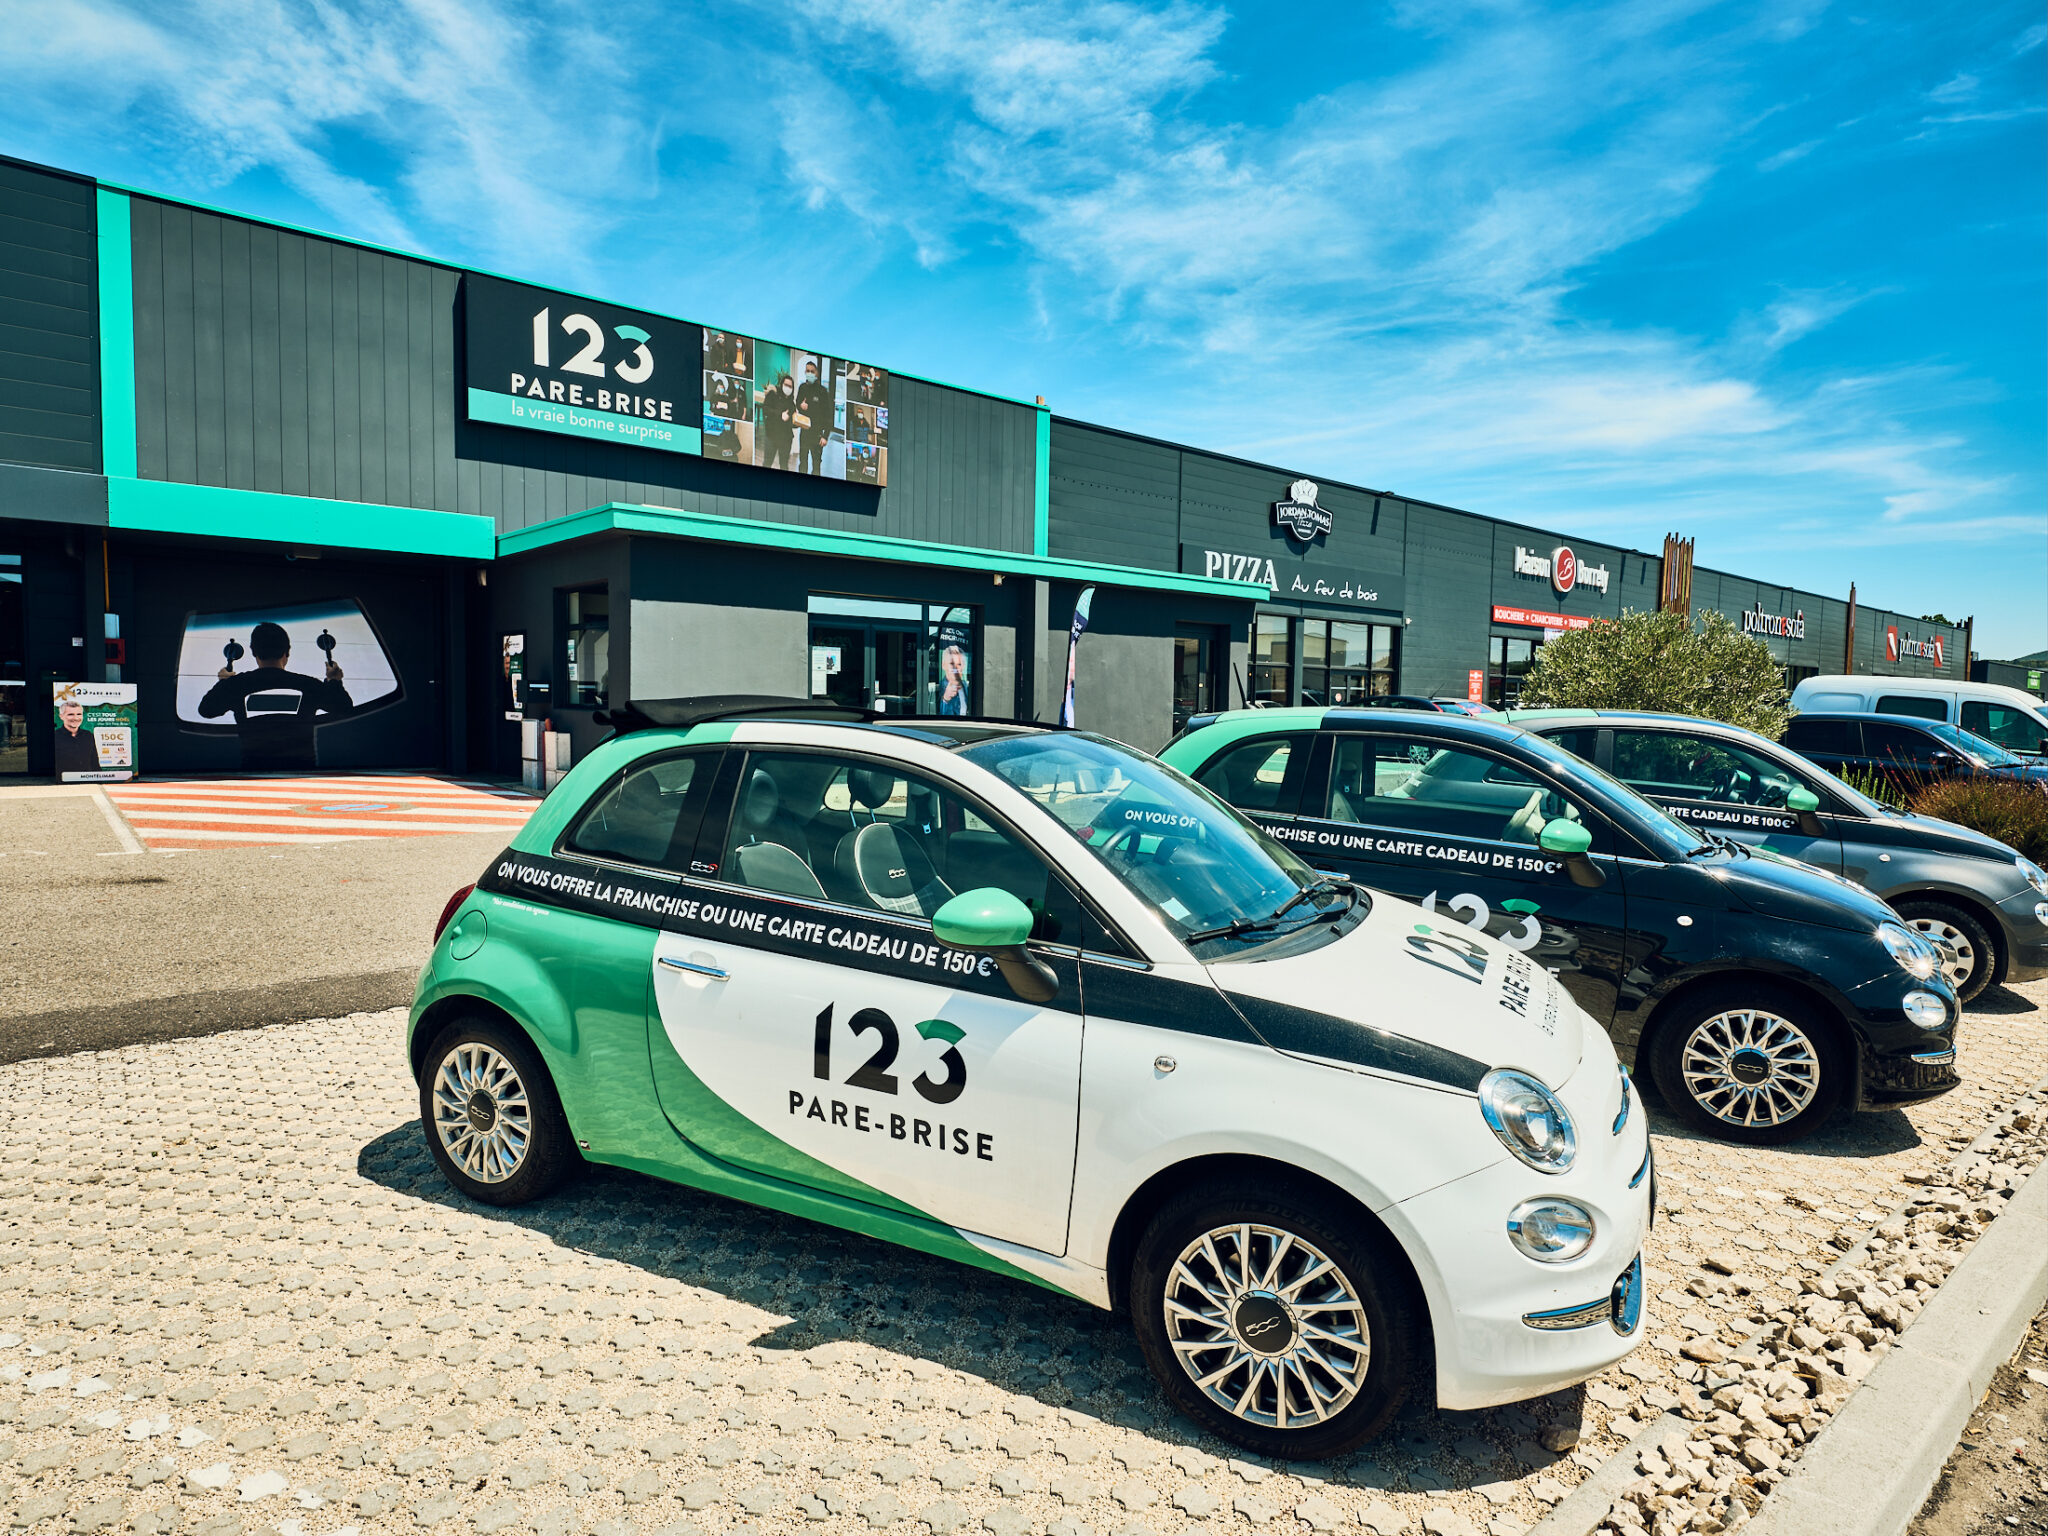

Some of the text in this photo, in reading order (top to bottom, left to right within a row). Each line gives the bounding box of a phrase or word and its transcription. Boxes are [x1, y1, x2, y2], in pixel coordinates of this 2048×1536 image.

[533, 306, 654, 384] 123
[511, 372, 673, 421] PARE-BRISE
[511, 399, 672, 441] la vraie bonne surprise
[1308, 509, 1331, 527] TOMAS
[1204, 550, 1378, 601] PIZZA Au feu de bois
[1514, 546, 1551, 578] Maison
[1494, 608, 1525, 622] BOUCHERIE
[1531, 613, 1564, 627] CHARCUTERIE
[1124, 809, 1143, 821] ON
[1145, 811, 1178, 826] VOUS
[1691, 808, 1741, 823] CADEAU
[1743, 813, 1760, 826] DE
[1318, 831, 1342, 848] OU
[1342, 835, 1374, 851] UNE
[1376, 839, 1423, 857] CARTE
[1425, 844, 1490, 866] CADEAU
[1492, 854, 1514, 870] DE
[497, 861, 515, 879] ON
[516, 865, 551, 888] VOUS
[551, 873, 594, 898] OFFRE
[594, 882, 613, 902] LA
[613, 886, 700, 920] FRANCHISE
[700, 903, 728, 925] OU
[729, 907, 767, 932] UNE
[767, 915, 826, 944] CARTE
[827, 926, 907, 960] CADEAU
[909, 942, 939, 967] DE
[1402, 923, 1489, 985] 123
[813, 1001, 967, 1105] 123
[788, 1089, 994, 1162] PARE-BRISE
